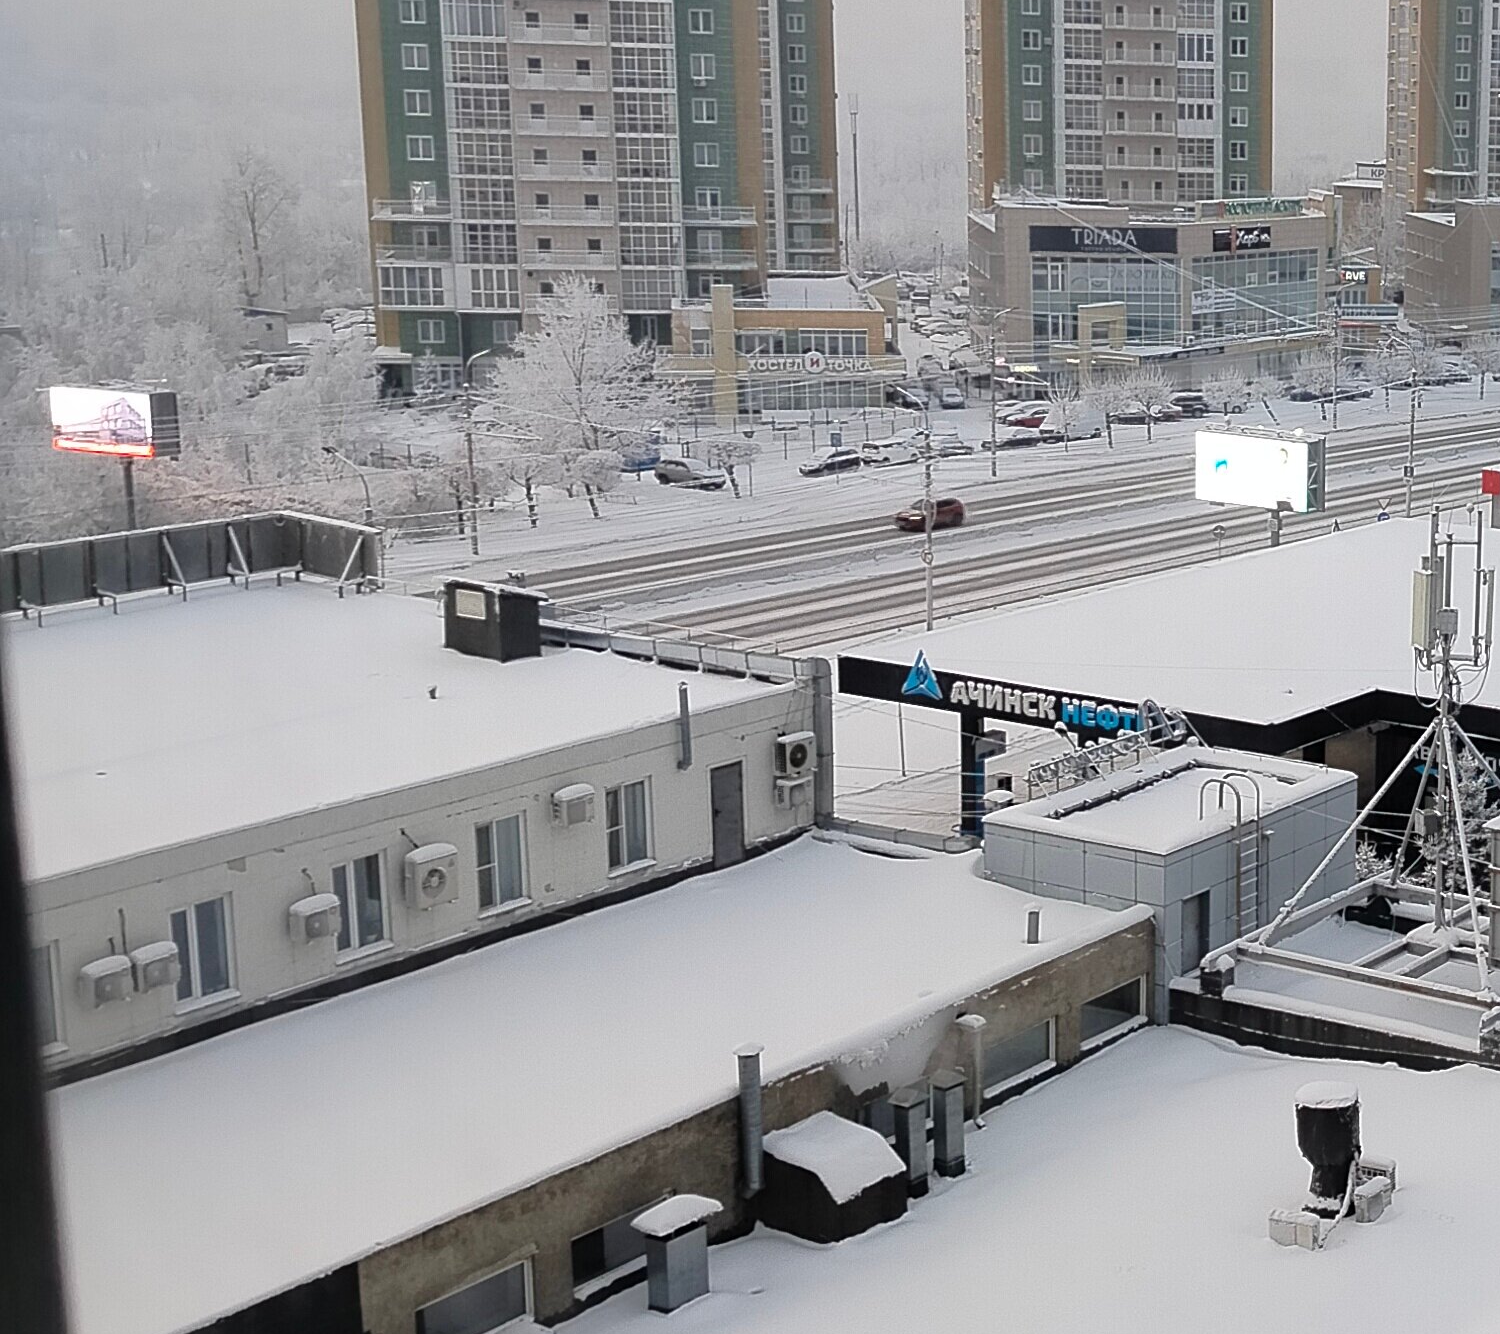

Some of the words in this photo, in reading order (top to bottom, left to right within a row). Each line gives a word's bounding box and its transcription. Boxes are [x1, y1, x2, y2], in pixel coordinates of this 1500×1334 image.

[1371, 168, 1387, 178] КР
[1071, 228, 1137, 246] TRIADA
[748, 358, 803, 371] ХОСТЕЛ
[827, 359, 872, 371] ТОЧКА
[950, 681, 1057, 721] АЧИНСК
